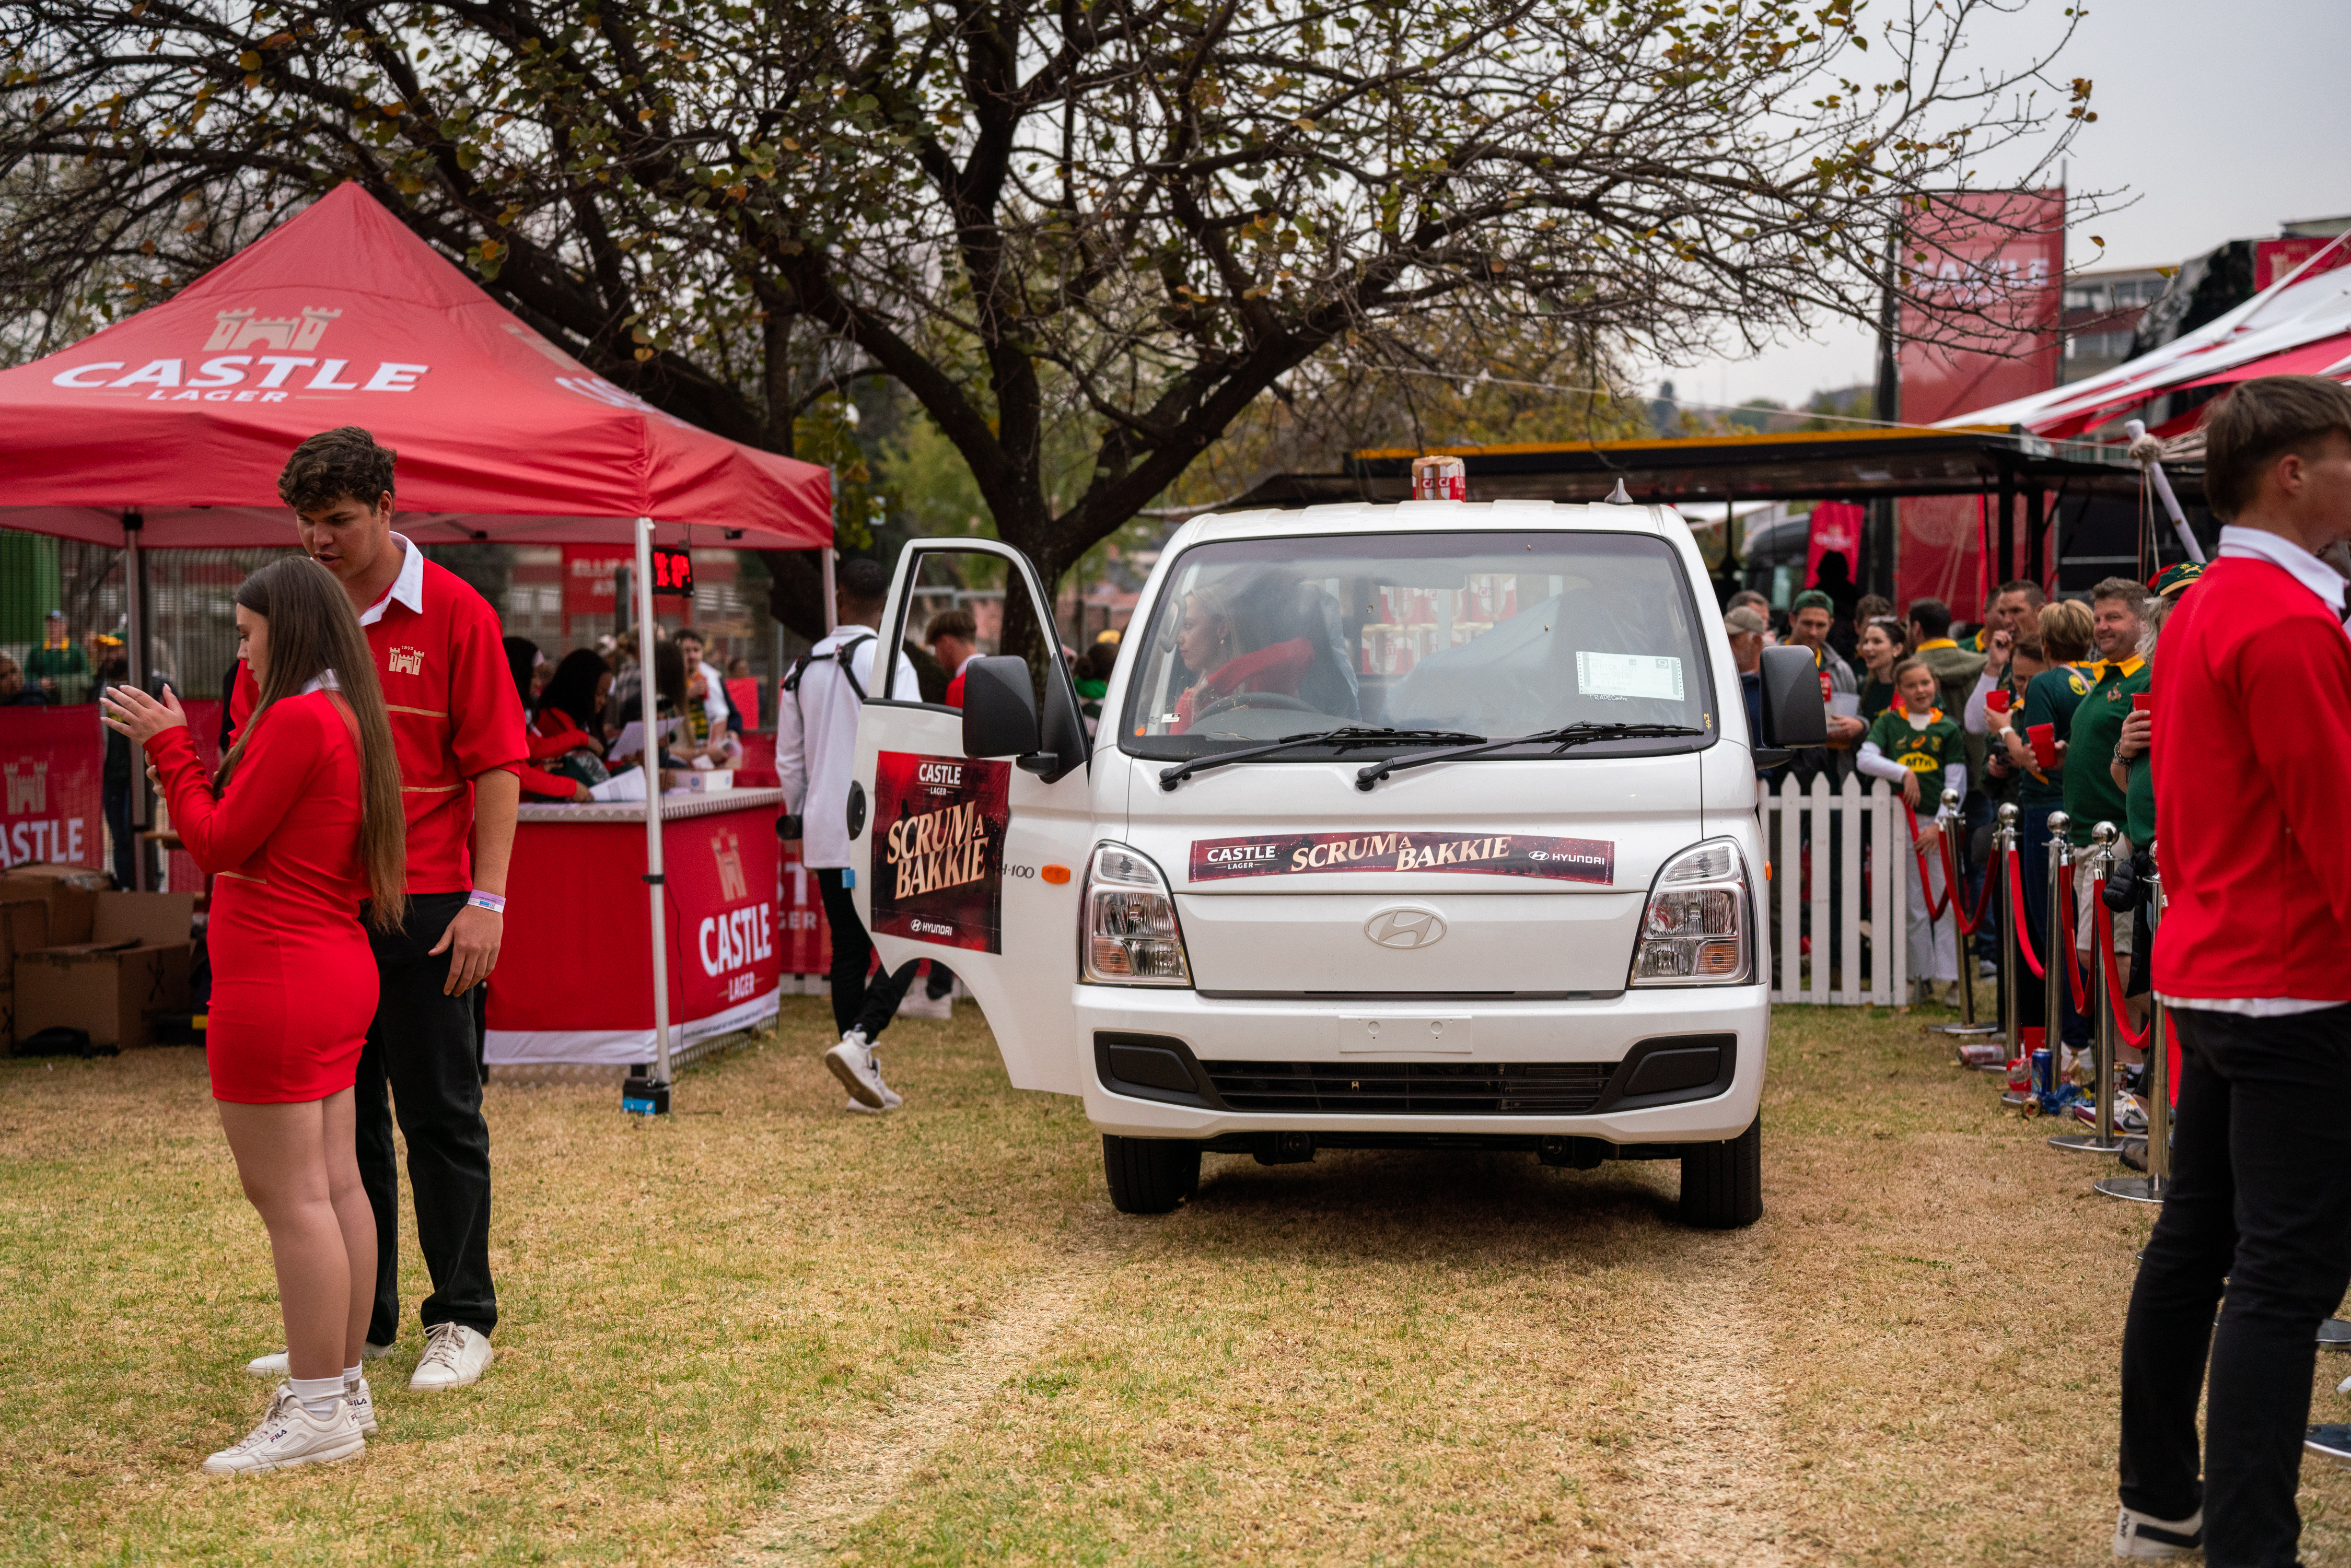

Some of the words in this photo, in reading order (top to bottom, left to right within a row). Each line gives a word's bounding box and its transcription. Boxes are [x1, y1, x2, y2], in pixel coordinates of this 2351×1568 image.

[52, 355, 429, 392] CASTLE
[147, 390, 288, 402] LAGER
[1584, 662, 1617, 671] S.AFRICA
[1657, 660, 1668, 668] 9
[1612, 671, 1633, 679] 00192
[918, 763, 962, 785] CASTLE
[930, 787, 947, 795] LAGER
[887, 801, 976, 864] SCRUM
[972, 814, 984, 837] A
[1398, 836, 1412, 849] A
[1207, 845, 1276, 862] CASTLE
[1290, 833, 1399, 872] SCRUM
[1395, 836, 1512, 871] BAKKIE
[1552, 853, 1605, 865] HYUNDAI
[894, 837, 989, 900] BAKKIE
[922, 922, 952, 936] HYUNDAI
[699, 902, 772, 977] CASTLE
[728, 971, 755, 1002] LAGER
[270, 1429, 288, 1443] FILA
